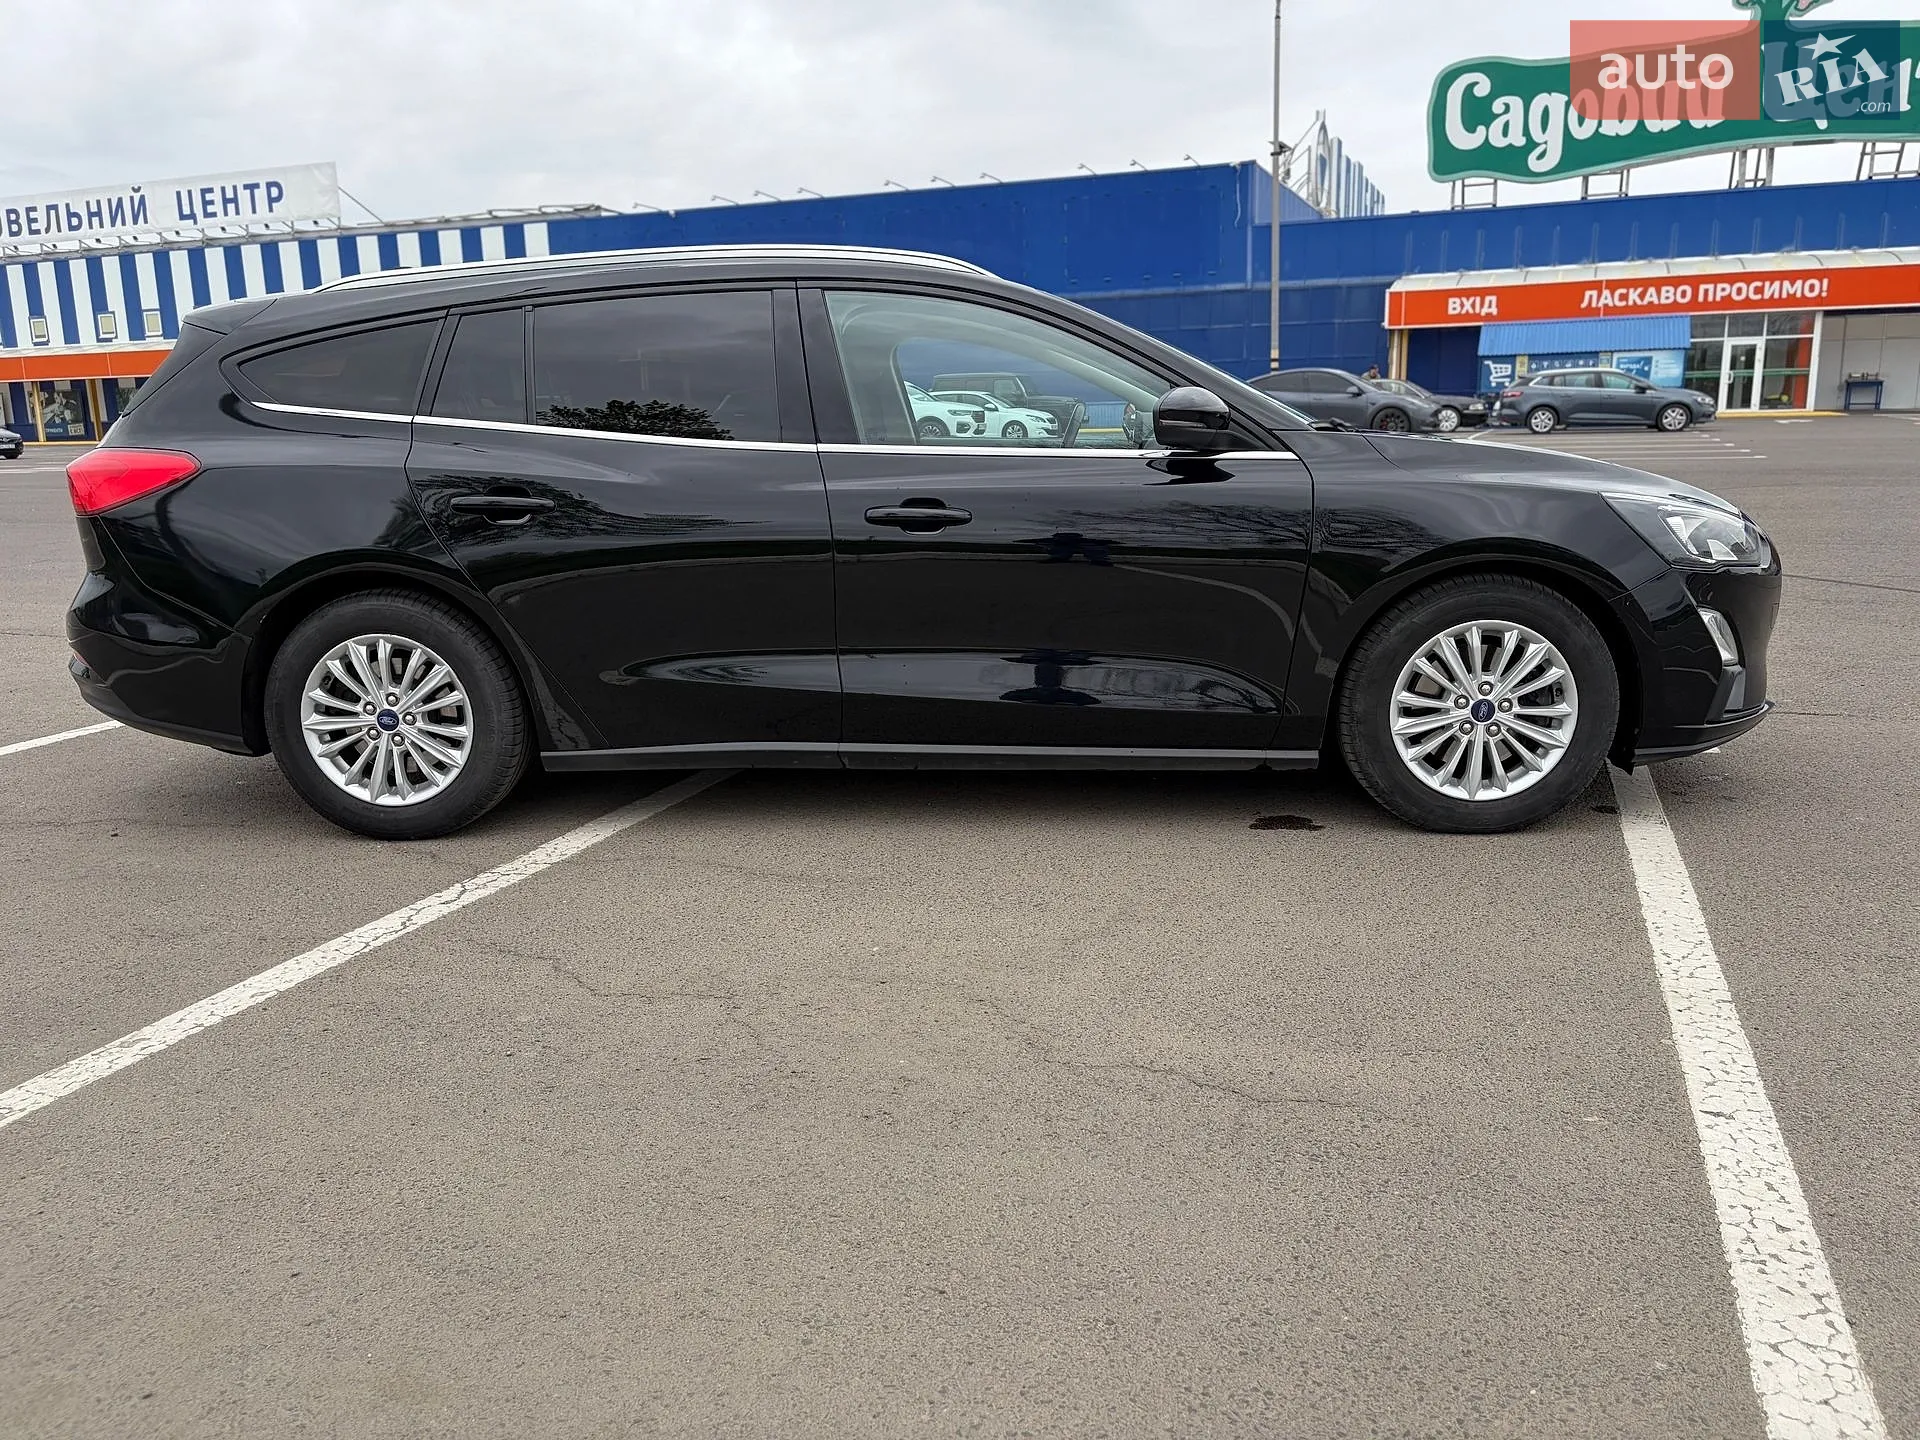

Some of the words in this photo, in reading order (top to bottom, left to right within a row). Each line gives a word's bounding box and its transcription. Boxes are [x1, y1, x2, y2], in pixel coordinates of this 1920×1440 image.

[1761, 37, 1920, 130] Цен
[0, 186, 149, 238] ВЕЛЬНИЙ
[176, 180, 285, 225] ЦЕНТР
[1447, 295, 1498, 316] ВХІД
[1580, 284, 1692, 309] ЛАСКАВО
[1697, 278, 1829, 303] ПРОСИМО!
